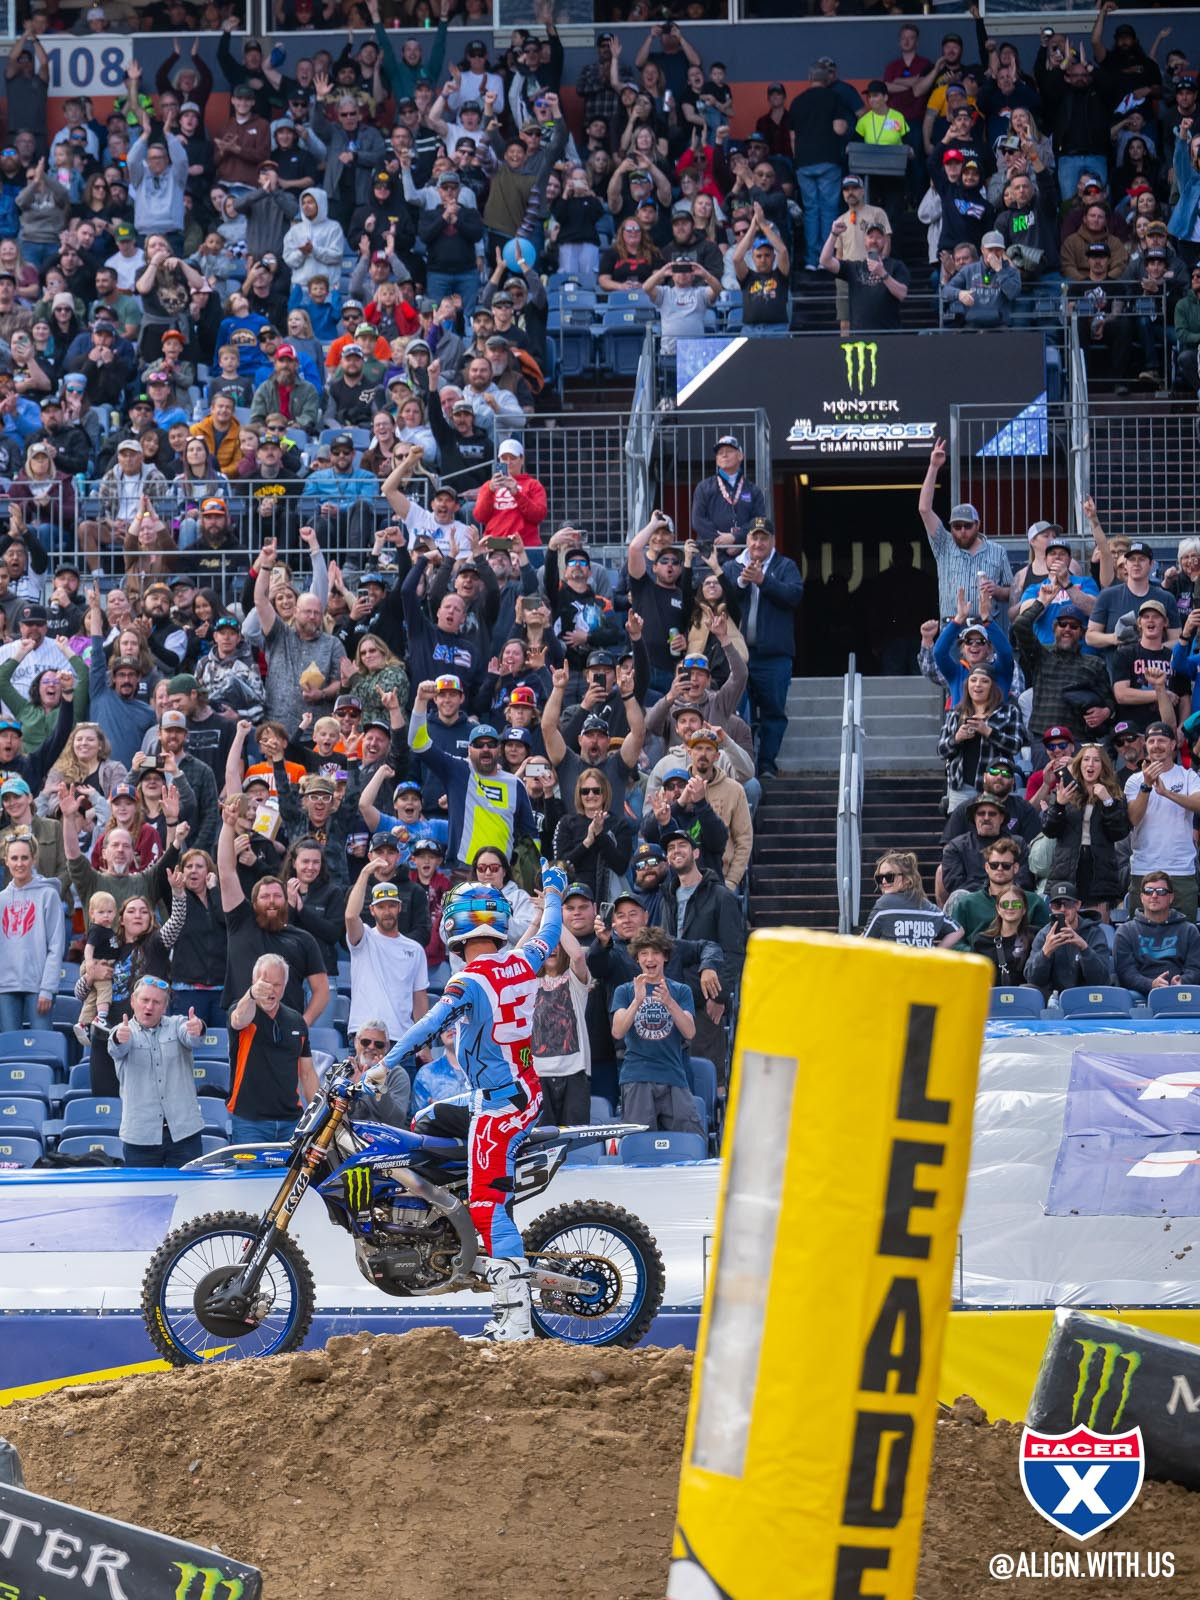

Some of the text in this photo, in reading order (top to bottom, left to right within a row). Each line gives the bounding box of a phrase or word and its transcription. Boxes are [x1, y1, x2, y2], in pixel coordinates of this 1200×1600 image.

[47, 46, 125, 87] 108
[822, 399, 900, 413] MONSTER
[785, 422, 938, 442] SUPERCROSS
[820, 440, 904, 453] CHAMPIONSHIP
[507, 729, 523, 740] 3
[894, 920, 936, 938] argus
[492, 982, 540, 1044] 3
[578, 1128, 626, 1138] DUNLOP
[373, 1159, 412, 1170] PROGRESSIVE
[154, 1305, 174, 1346] DUNLOP
